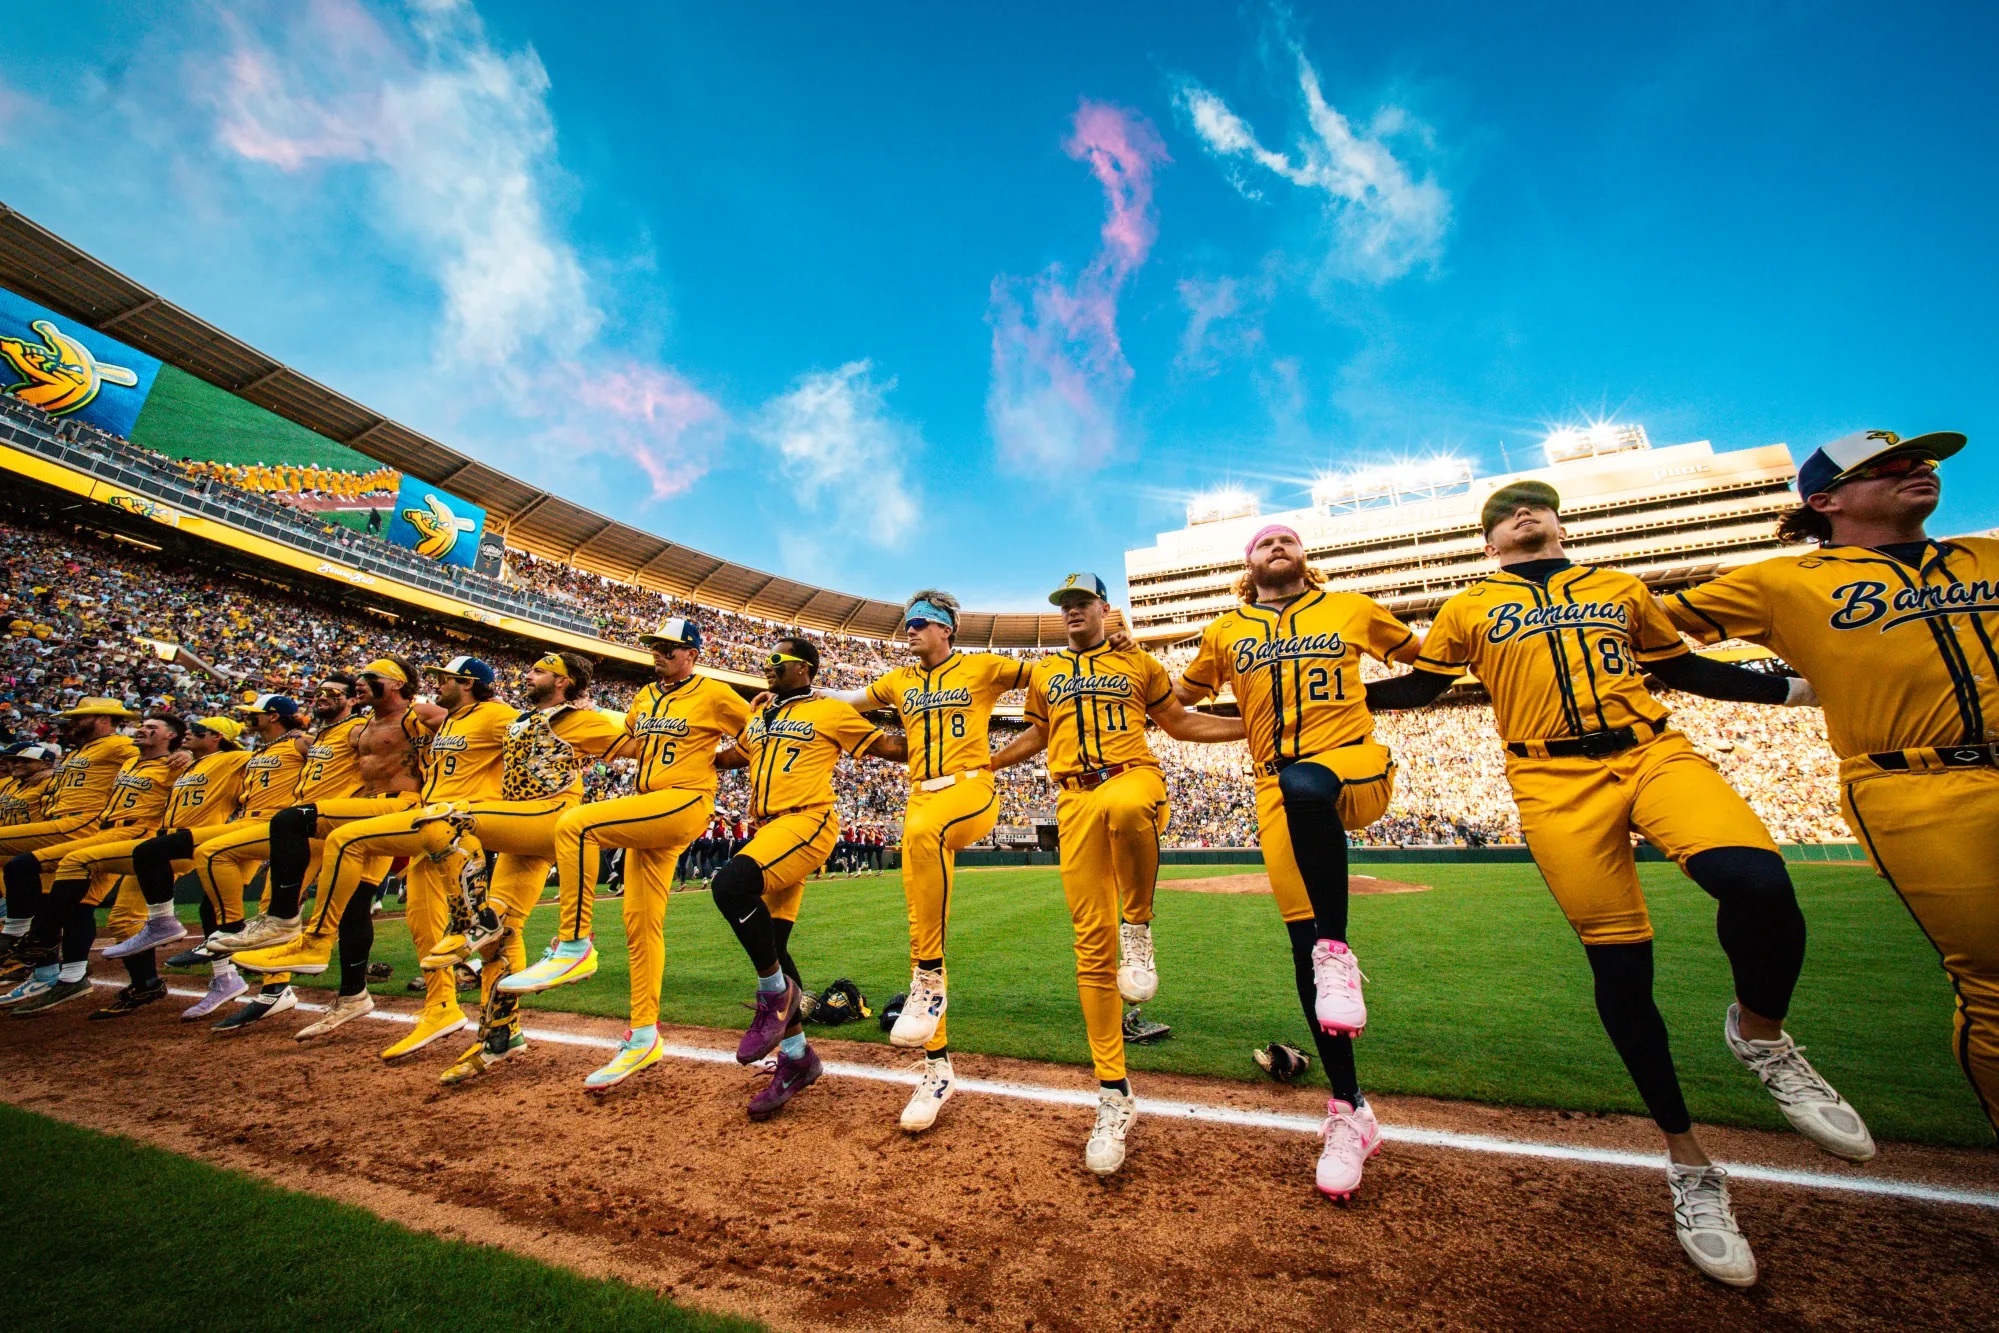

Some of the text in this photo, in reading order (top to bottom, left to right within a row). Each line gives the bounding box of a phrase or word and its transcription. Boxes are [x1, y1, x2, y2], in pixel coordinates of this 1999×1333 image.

[1487, 600, 1630, 644] Bananas
[1232, 631, 1347, 675] Bananas
[1047, 671, 1133, 707] Bananas
[1307, 666, 1346, 702] 21
[902, 685, 972, 717] Bananas
[950, 712, 967, 739] 8
[1104, 702, 1129, 733] 11
[443, 754, 457, 777] 9
[660, 740, 677, 766] 6
[781, 746, 801, 774] 7
[66, 771, 87, 788] 12
[259, 771, 270, 788] 4
[312, 763, 324, 781] 2
[123, 792, 140, 809] 5
[181, 789, 206, 807] 15
